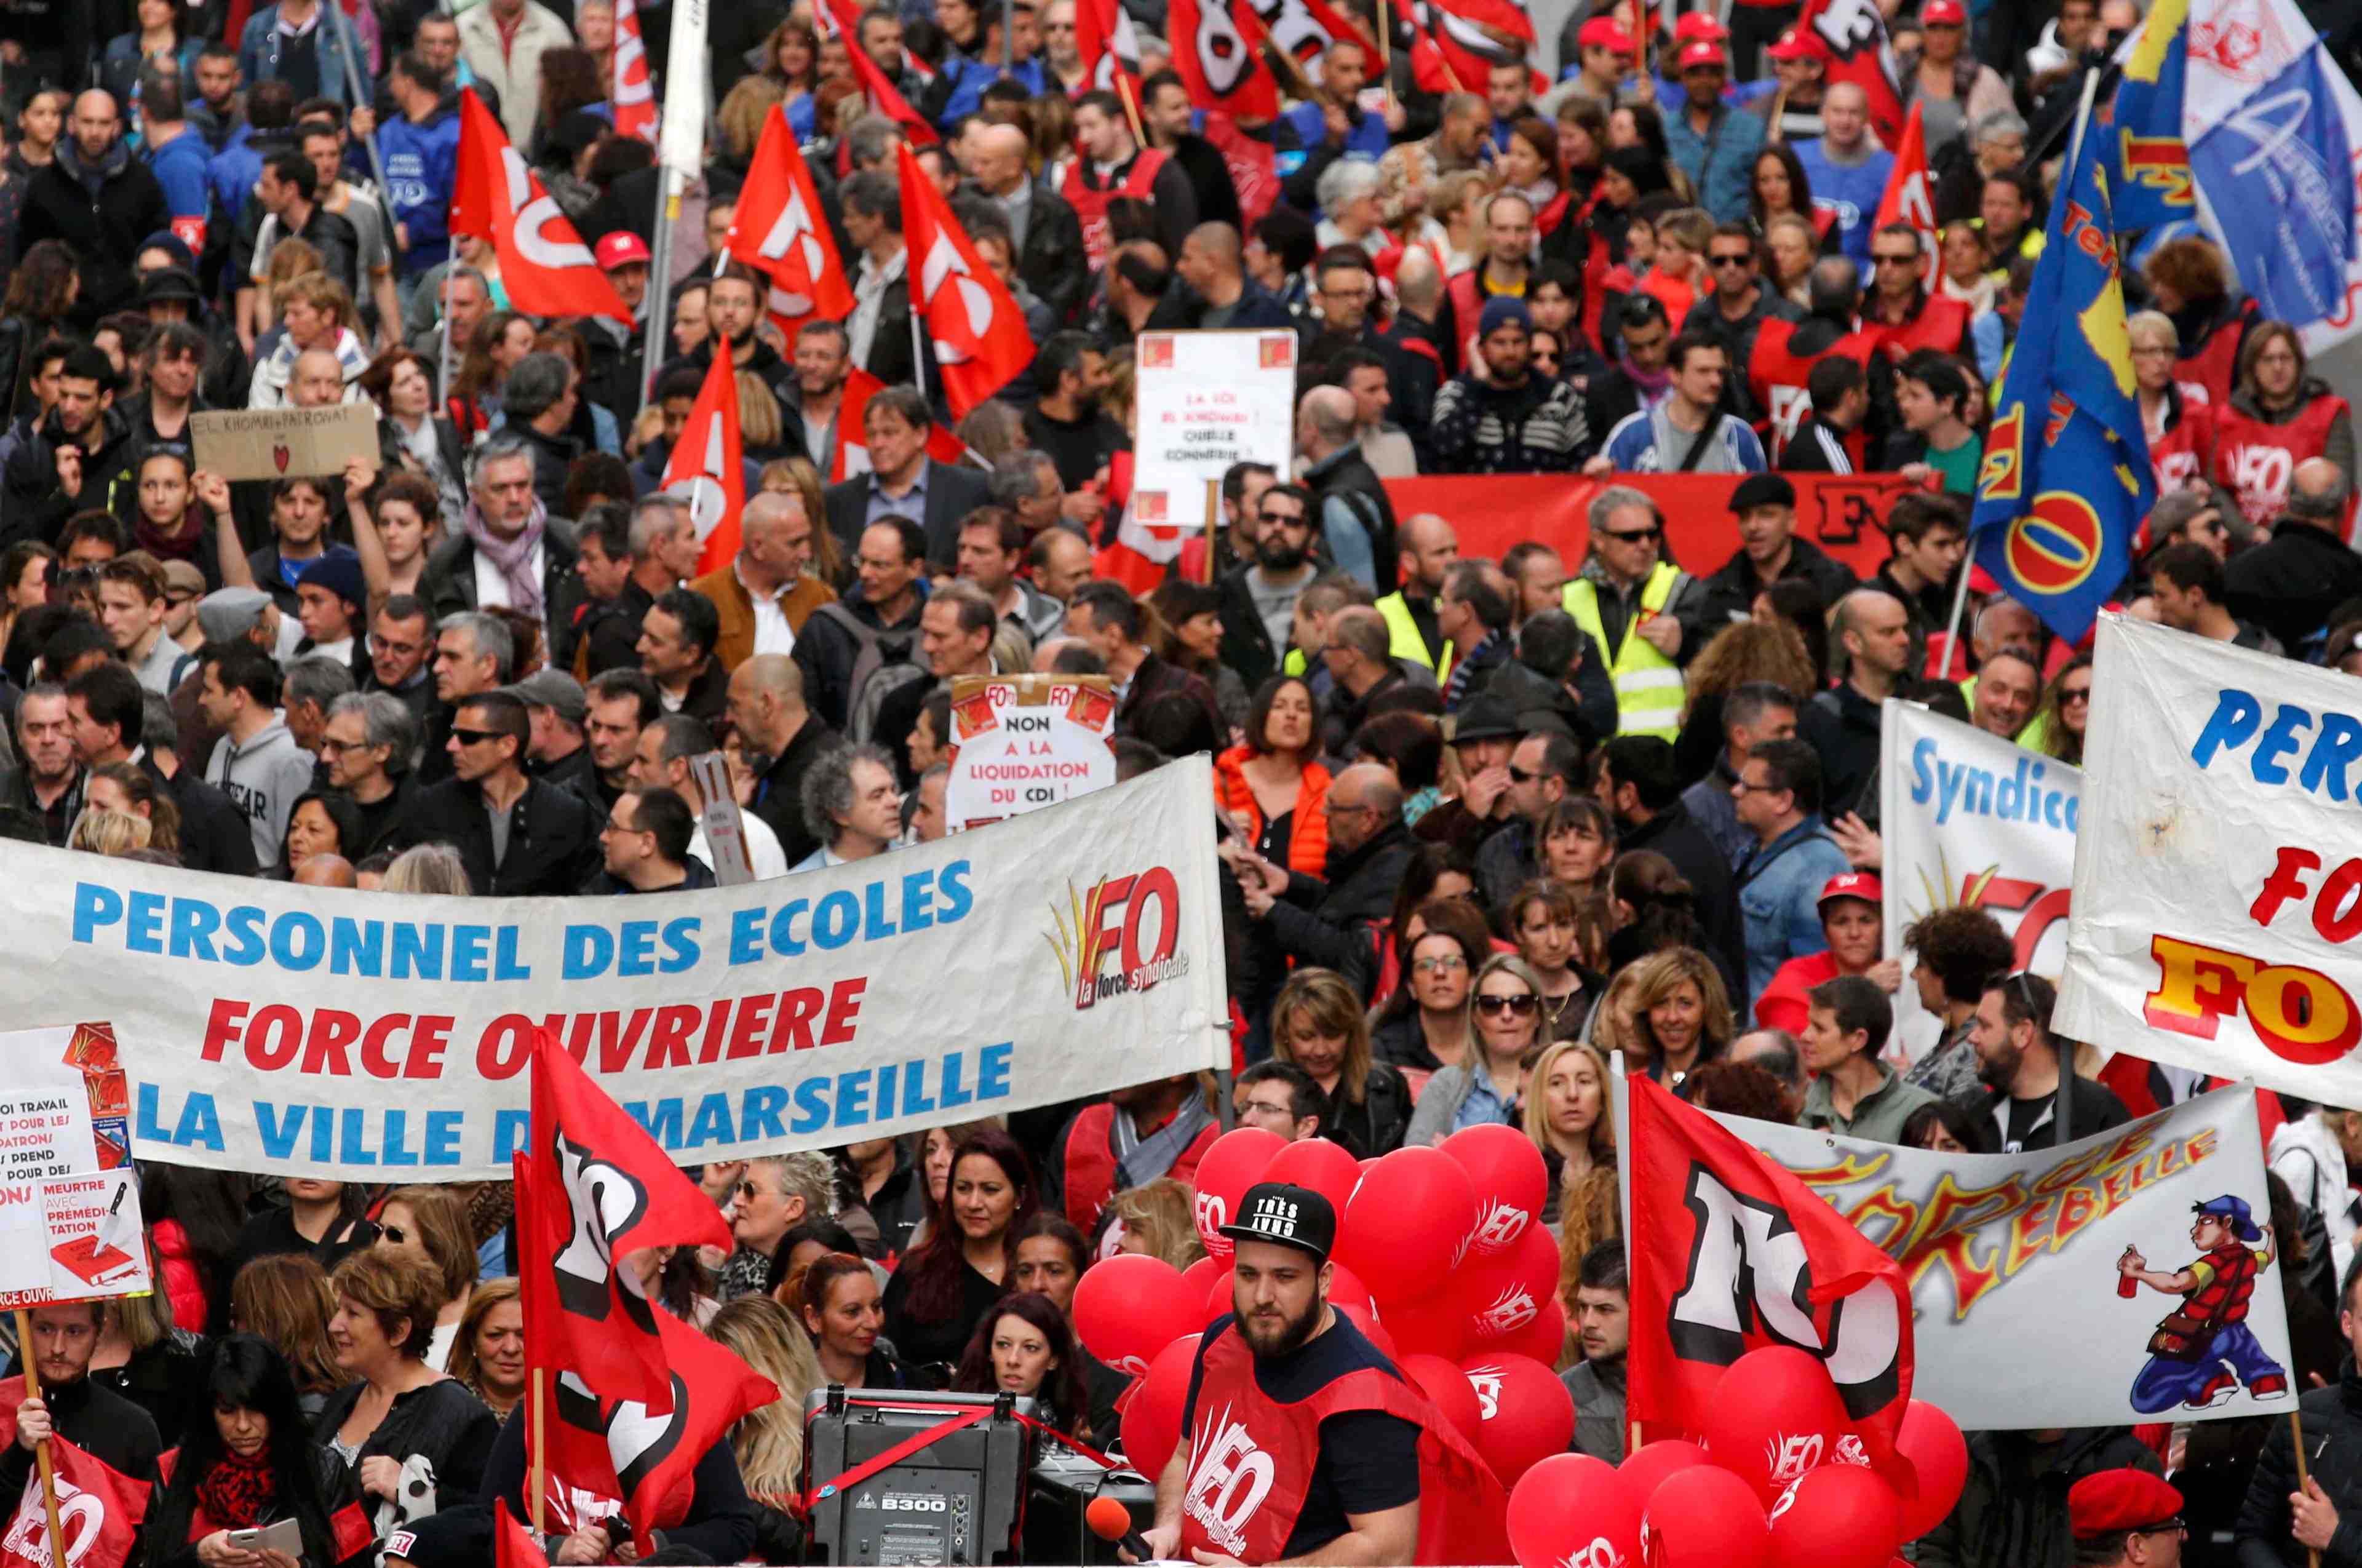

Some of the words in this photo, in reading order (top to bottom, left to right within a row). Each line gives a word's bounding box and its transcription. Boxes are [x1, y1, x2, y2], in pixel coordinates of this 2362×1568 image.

[1006, 717, 1049, 732] NON
[1005, 741, 1018, 756] A
[1028, 741, 1052, 755] LA
[2192, 689, 2362, 807] PER
[971, 762, 1089, 781] LIQUIDATION
[992, 789, 1015, 803] DU
[1025, 788, 1054, 802] CDI
[73, 883, 531, 982] PERSONNEL
[562, 917, 701, 981] DES
[729, 860, 973, 966] ECOLES
[1077, 867, 1179, 1009] FO
[1078, 979, 1092, 1005] la
[1097, 973, 1129, 1000] force
[1130, 952, 1190, 993] syndicale
[2143, 934, 2362, 1065] FO
[201, 998, 455, 1079] FORCE
[20, 1098, 68, 1113] TRAVAIL
[137, 1083, 225, 1151] LA
[253, 1102, 463, 1166] VILLE
[492, 1110, 530, 1164] D
[621, 1043, 1014, 1150] MARSEILLE
[10, 1118, 44, 1131] POUR
[51, 1115, 69, 1126] LES
[12, 1150, 55, 1163] PREND
[7, 1168, 42, 1180] POUR
[49, 1164, 70, 1176] DES
[44, 1180, 105, 1196] MEURTRE
[46, 1196, 78, 1209] AVEC
[47, 1206, 109, 1222] PRÉMÉDI-
[49, 1222, 96, 1235] TATION
[1775, 1434, 1824, 1474] FO
[1191, 1422, 1274, 1536] FO
[881, 1498, 946, 1512] B300
